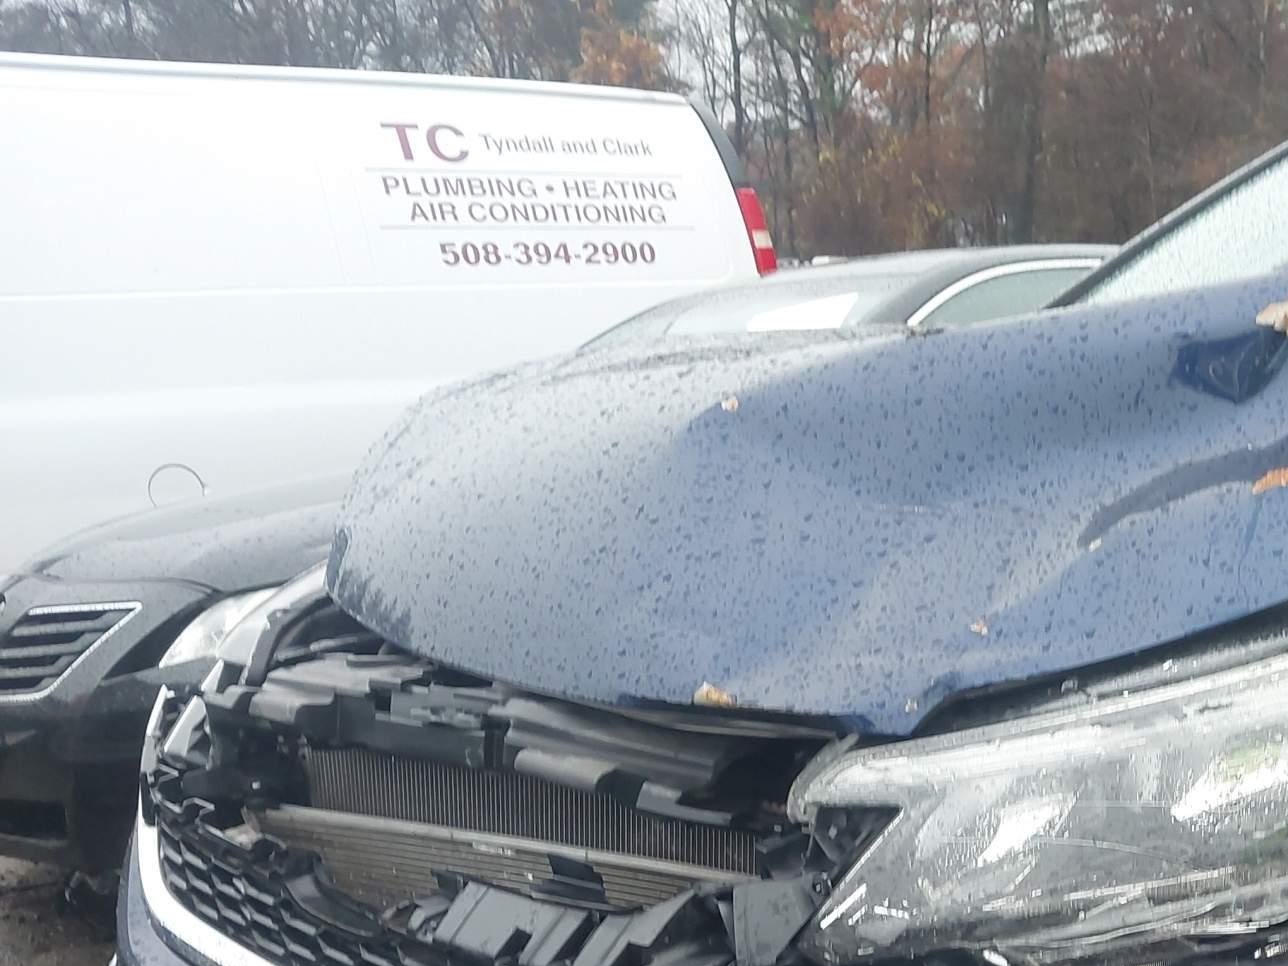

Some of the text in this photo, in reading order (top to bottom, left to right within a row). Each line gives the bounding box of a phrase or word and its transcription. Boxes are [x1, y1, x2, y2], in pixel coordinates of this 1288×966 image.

[380, 122, 653, 163] TC Tyndall and Clark
[381, 175, 537, 199] PLUMBING
[563, 180, 677, 201] HEATING
[410, 201, 666, 225] AIR CONDITIONING
[440, 241, 656, 267] 508-394-2900
